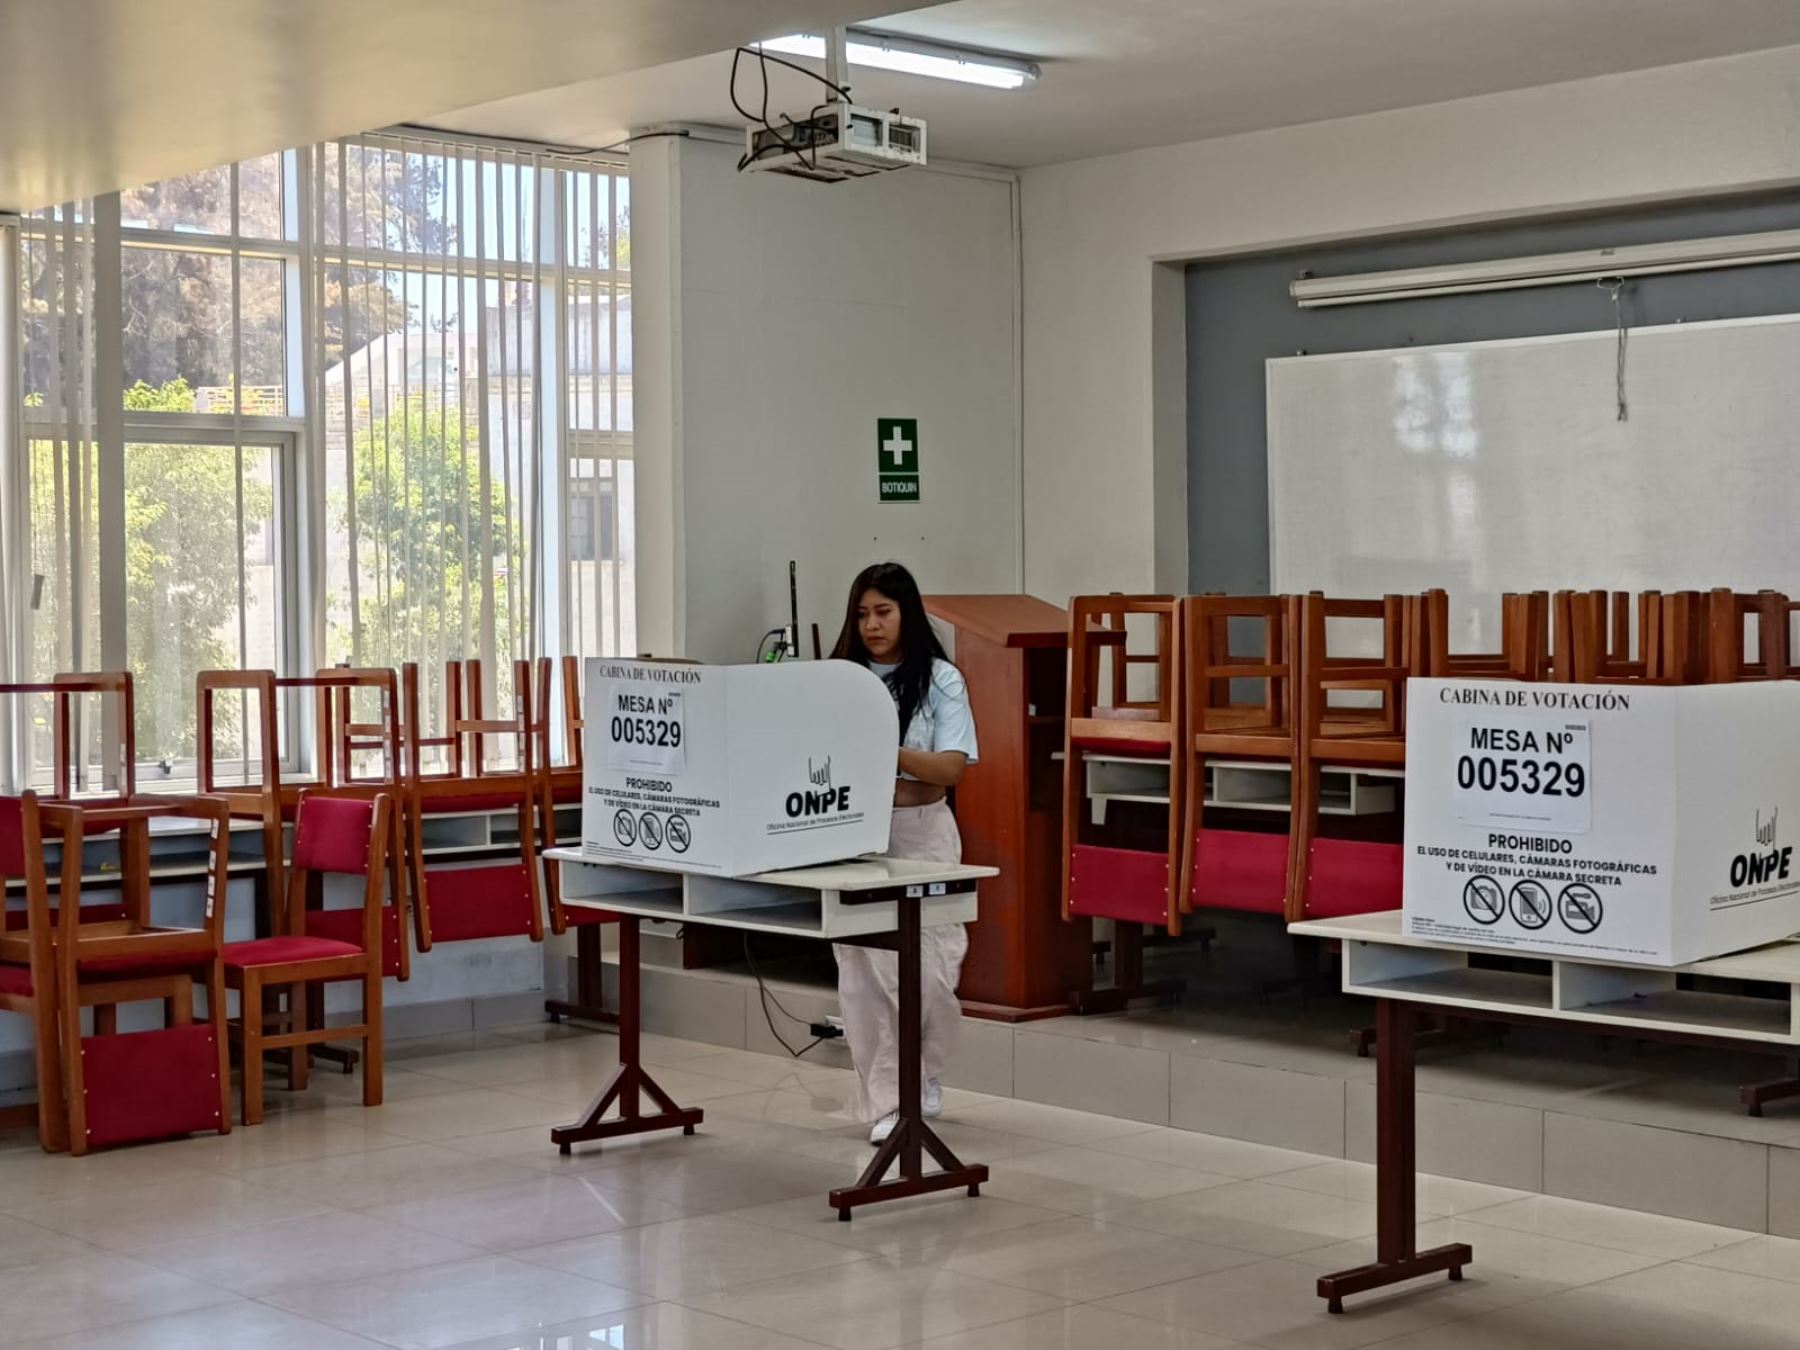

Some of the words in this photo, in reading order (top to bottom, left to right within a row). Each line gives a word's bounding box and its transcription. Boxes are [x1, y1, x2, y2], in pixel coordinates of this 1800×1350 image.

[881, 482, 918, 493] BOTIQUIN
[600, 665, 632, 680] CABINA
[633, 667, 645, 680] DE
[647, 667, 702, 684] VOTACIÓN
[618, 694, 655, 714] MESA
[1440, 687, 1500, 706] CABINA
[1505, 690, 1527, 707] DE
[1532, 690, 1630, 710] VOTACIÓN
[611, 716, 682, 748] 005329
[1471, 727, 1539, 753] MESA
[626, 777, 672, 792] PROHIBIDO
[1457, 755, 1585, 797] 005329
[786, 786, 851, 818] ONPE
[1488, 833, 1572, 854] PROHIBIDO
[1417, 846, 1426, 855] EL
[1428, 847, 1447, 857] USO
[1448, 849, 1460, 858] DE
[1461, 850, 1517, 864] CELULARES,
[1519, 853, 1571, 868] CÁMARAS
[1573, 859, 1657, 875] FOTOGRÁFICAS
[1730, 846, 1792, 888] ONPE
[1446, 862, 1452, 870] Y
[1454, 863, 1466, 872] DE
[1467, 862, 1497, 874] VÍDEO
[1499, 866, 1511, 875] EN
[1513, 868, 1525, 877] LA
[1527, 868, 1573, 882] CÁMARA
[1575, 873, 1622, 885] SECRETA
